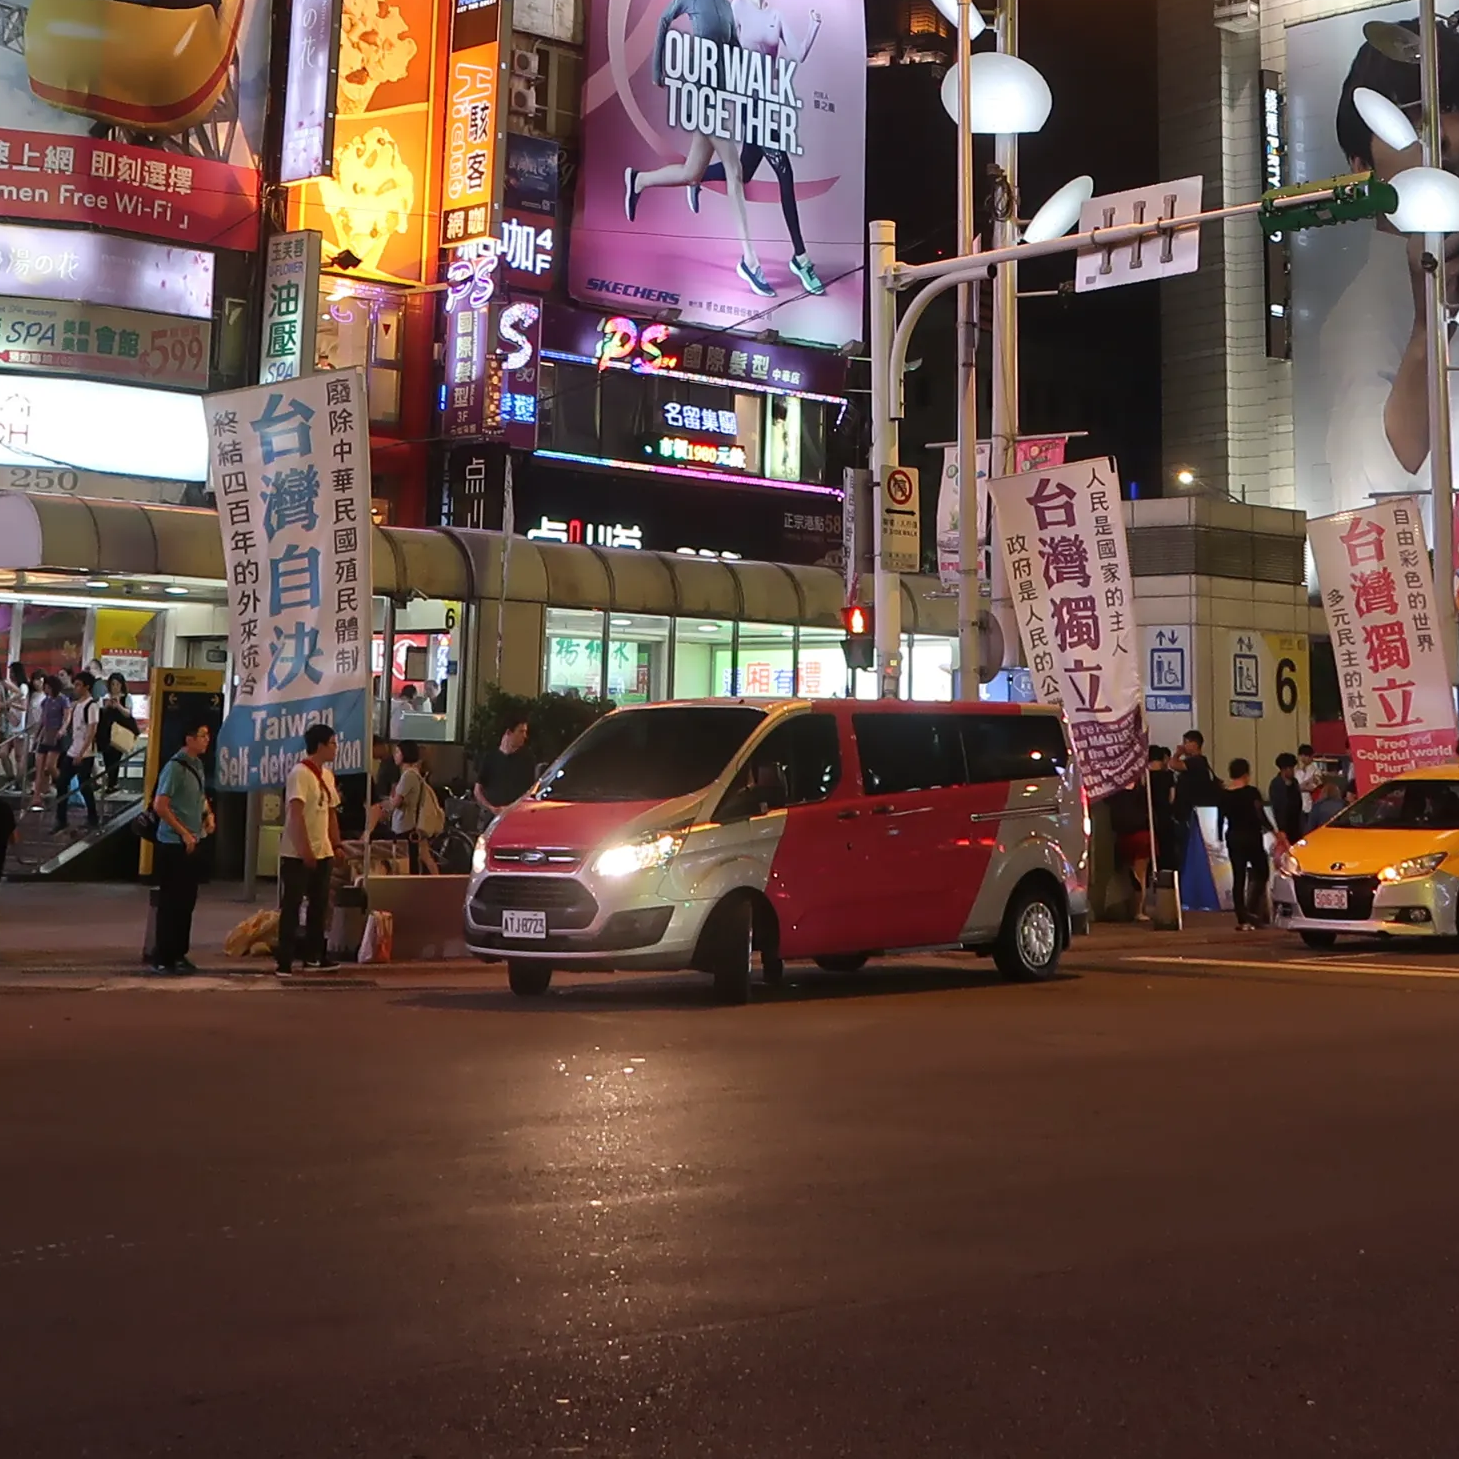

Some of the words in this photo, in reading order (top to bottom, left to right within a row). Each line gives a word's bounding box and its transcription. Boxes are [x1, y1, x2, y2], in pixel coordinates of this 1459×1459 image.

[663, 30, 718, 85] OUR
[724, 45, 804, 109] WALK.
[665, 77, 804, 156] TOGETHER.
[466, 101, 492, 193] 駭客
[91, 150, 193, 196] 即刻選擇
[58, 184, 108, 211] Free
[117, 197, 173, 223] Wi-Fi
[446, 207, 486, 240] 網咖
[5, 247, 80, 281] 湯の花
[271, 237, 305, 260] 玉芙蓉
[585, 276, 681, 307] SKECHERS
[6, 320, 56, 347] SPA
[265, 283, 300, 358] 油壓
[683, 343, 770, 382] 國際髮型
[662, 402, 739, 437] 名留集團
[249, 392, 325, 693] 台灣自決
[325, 377, 360, 675] 廢除中華民國殖民體制
[212, 409, 262, 697] 終結四百年的外來統治
[1086, 467, 1129, 657] 人民是國家的主人
[1026, 477, 1113, 714] 台灣獨立
[1391, 509, 1435, 653] 自由彩色的世界
[1339, 516, 1424, 729] 台灣獨立
[1326, 587, 1370, 730] 多元民主的社會
[1275, 657, 1299, 714] 6
[252, 706, 334, 743] Taiwan
[1375, 736, 1405, 750] Free
[1356, 747, 1411, 762] Colorful
[1412, 744, 1453, 758] world
[1374, 759, 1416, 774] Plural
